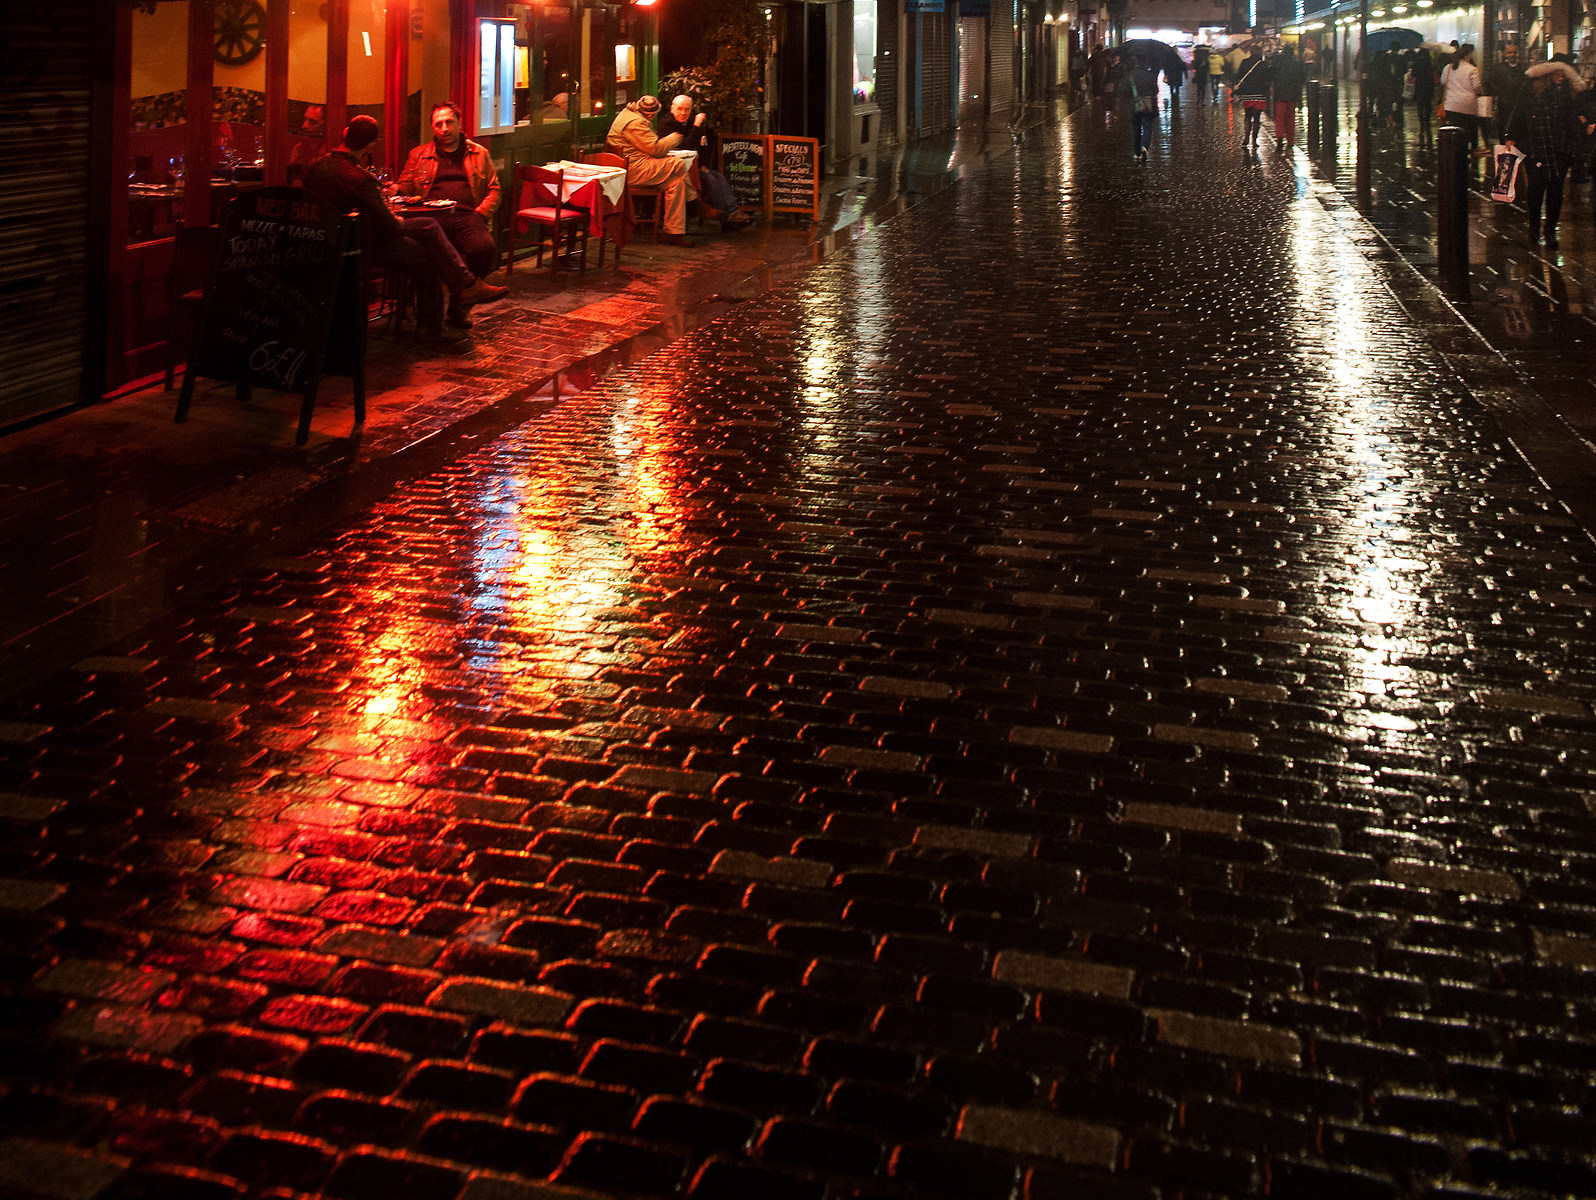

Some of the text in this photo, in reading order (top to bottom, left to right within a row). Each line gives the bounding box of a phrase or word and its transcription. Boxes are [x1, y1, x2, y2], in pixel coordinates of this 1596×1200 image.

[289, 201, 320, 221] BAR
[287, 225, 326, 241] TAPAS
[228, 234, 278, 255] TODAY
[220, 250, 281, 271] SPANISH
